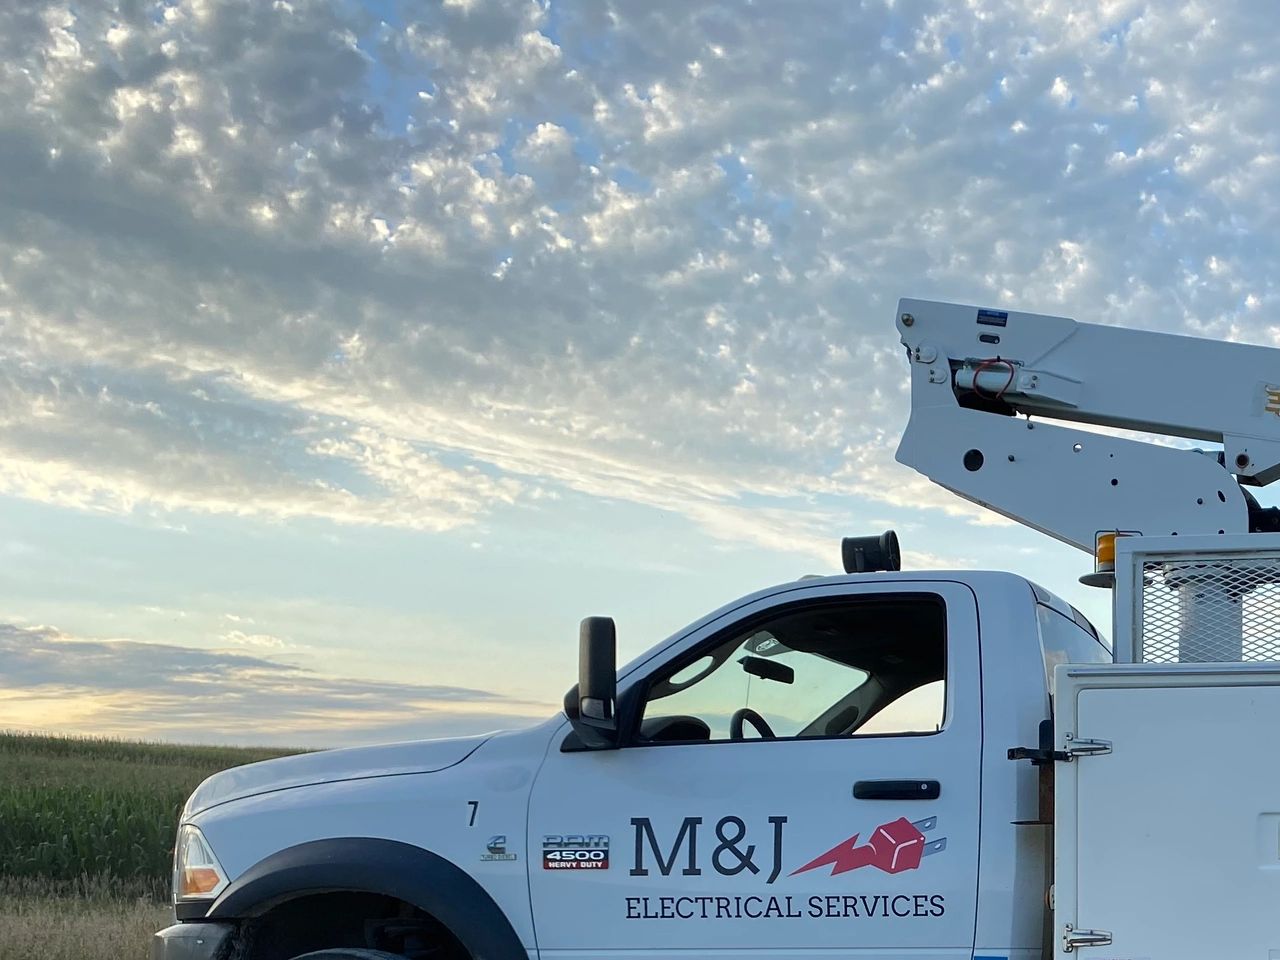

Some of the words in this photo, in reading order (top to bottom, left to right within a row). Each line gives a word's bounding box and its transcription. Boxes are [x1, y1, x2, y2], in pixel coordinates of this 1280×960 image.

[468, 801, 479, 827] 7
[542, 835, 610, 849] RAM
[629, 815, 788, 884] M&J
[546, 851, 605, 860] 4500
[625, 896, 802, 918] ELECTRICAL
[808, 895, 945, 918] SERVICES
